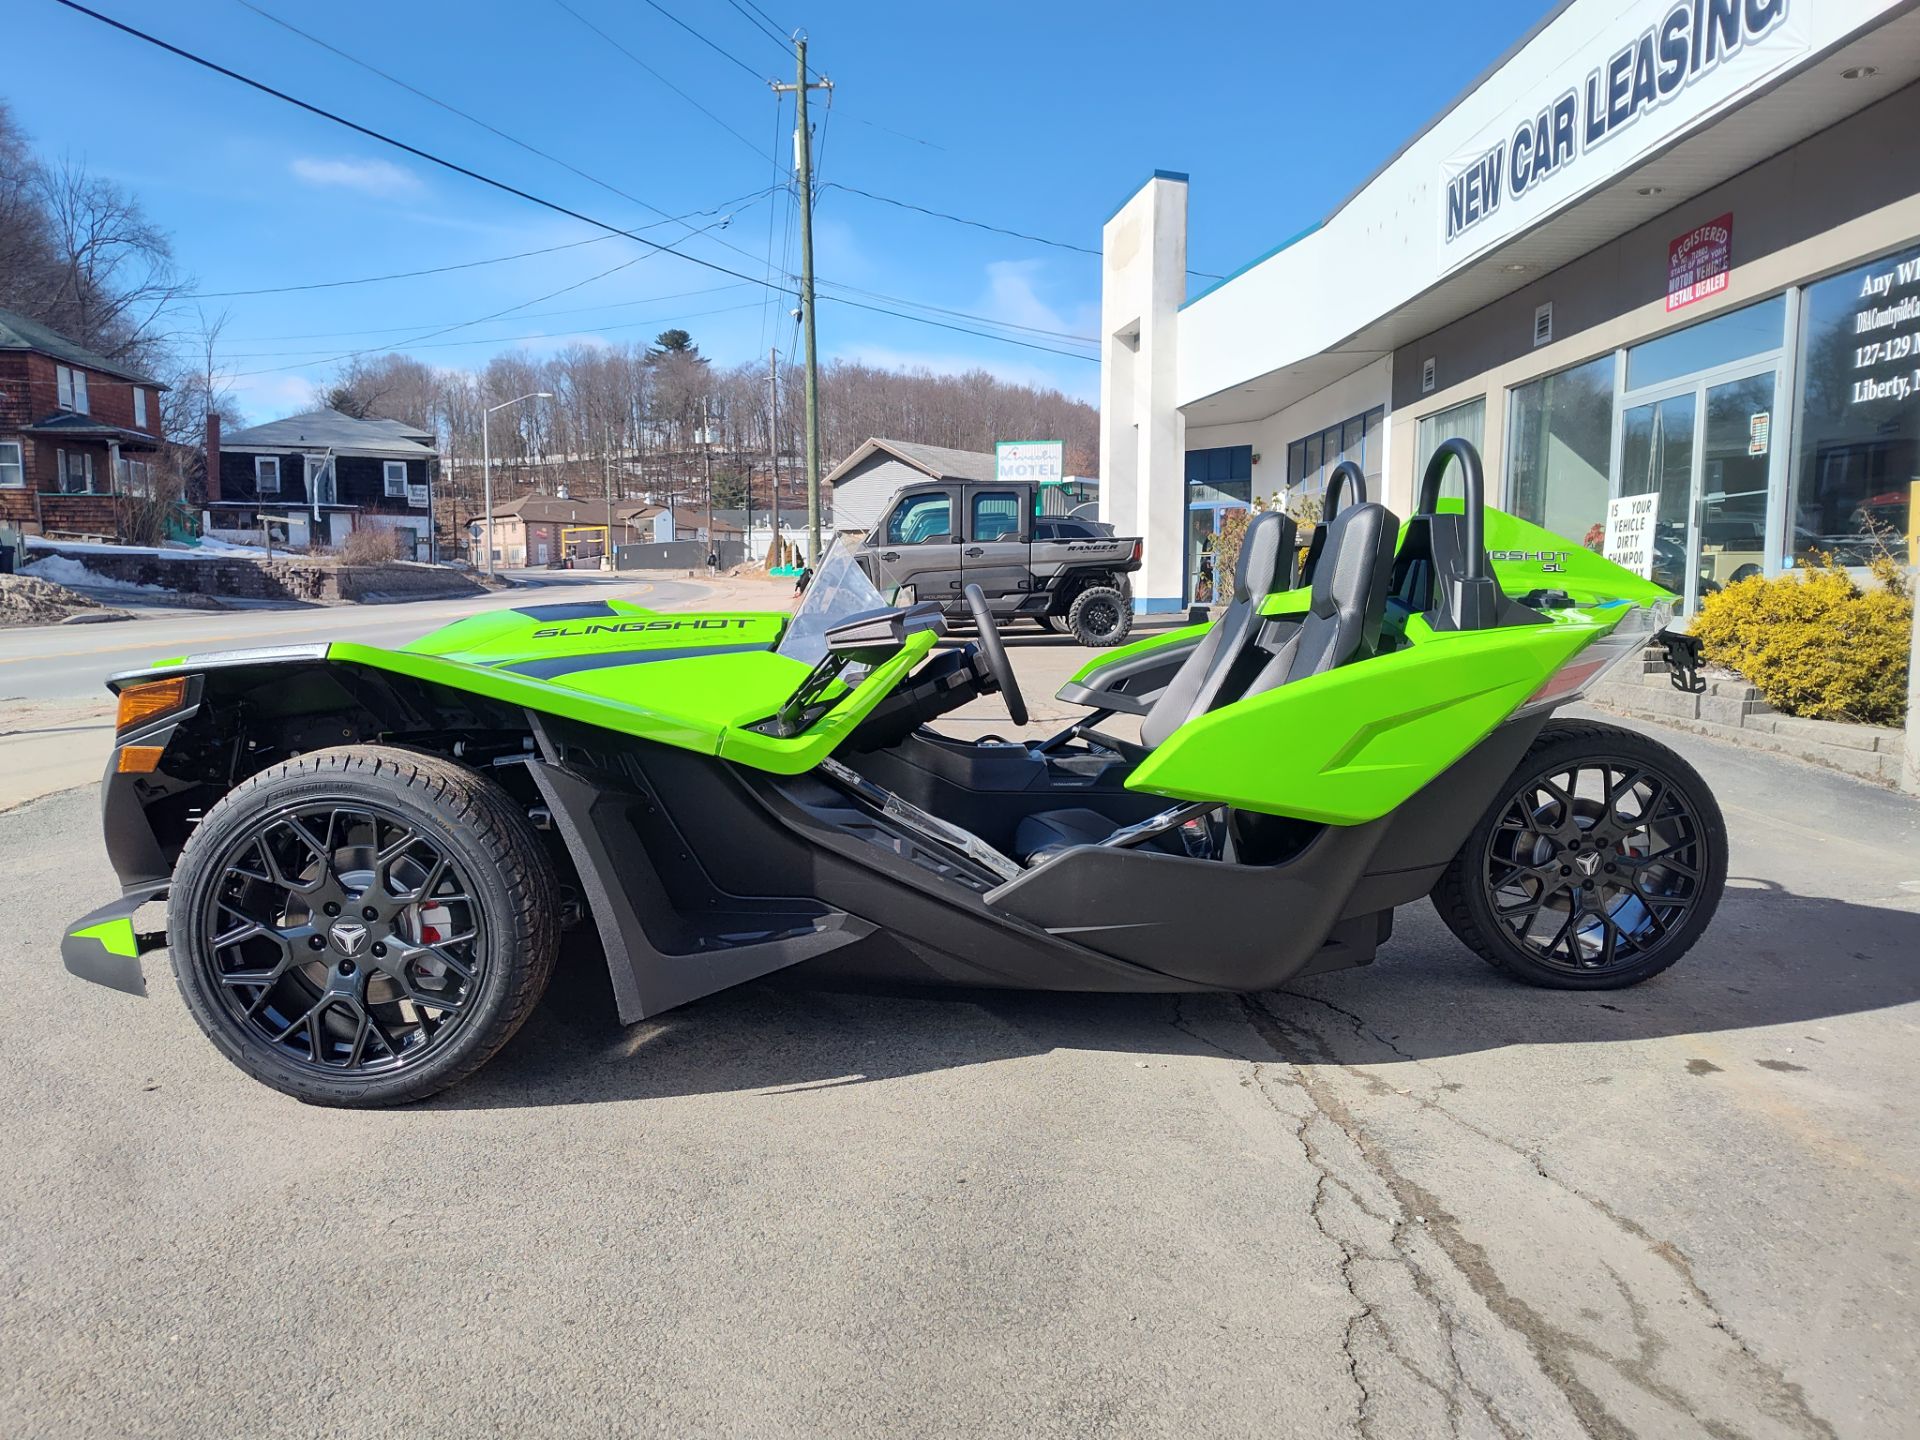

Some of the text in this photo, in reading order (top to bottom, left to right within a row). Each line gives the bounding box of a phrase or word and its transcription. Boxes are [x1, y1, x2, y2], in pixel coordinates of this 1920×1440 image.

[1446, 145, 1504, 239] NEW
[1510, 101, 1577, 194] CAR
[1671, 226, 1728, 267] REGISTERED
[1670, 264, 1687, 277] STATE
[1696, 252, 1710, 266] NEW
[1711, 245, 1727, 259] YORK
[1669, 255, 1728, 293] MOTOR VEHICLE
[1859, 273, 1895, 298] Any
[1668, 272, 1726, 309] RETAIL DEALER
[1855, 334, 1911, 369] 127-129
[1852, 375, 1911, 403] Liberty,
[1000, 463, 1059, 477] MOTEL
[1611, 499, 1652, 518] IS YOUR
[1614, 516, 1646, 533] VEHICLE
[1067, 544, 1119, 552] RANGER
[1616, 534, 1640, 550] DIRTY
[1542, 563, 1567, 572] SL
[1608, 550, 1644, 566] SHAMPOO
[532, 618, 757, 639] SLINGSHOT
